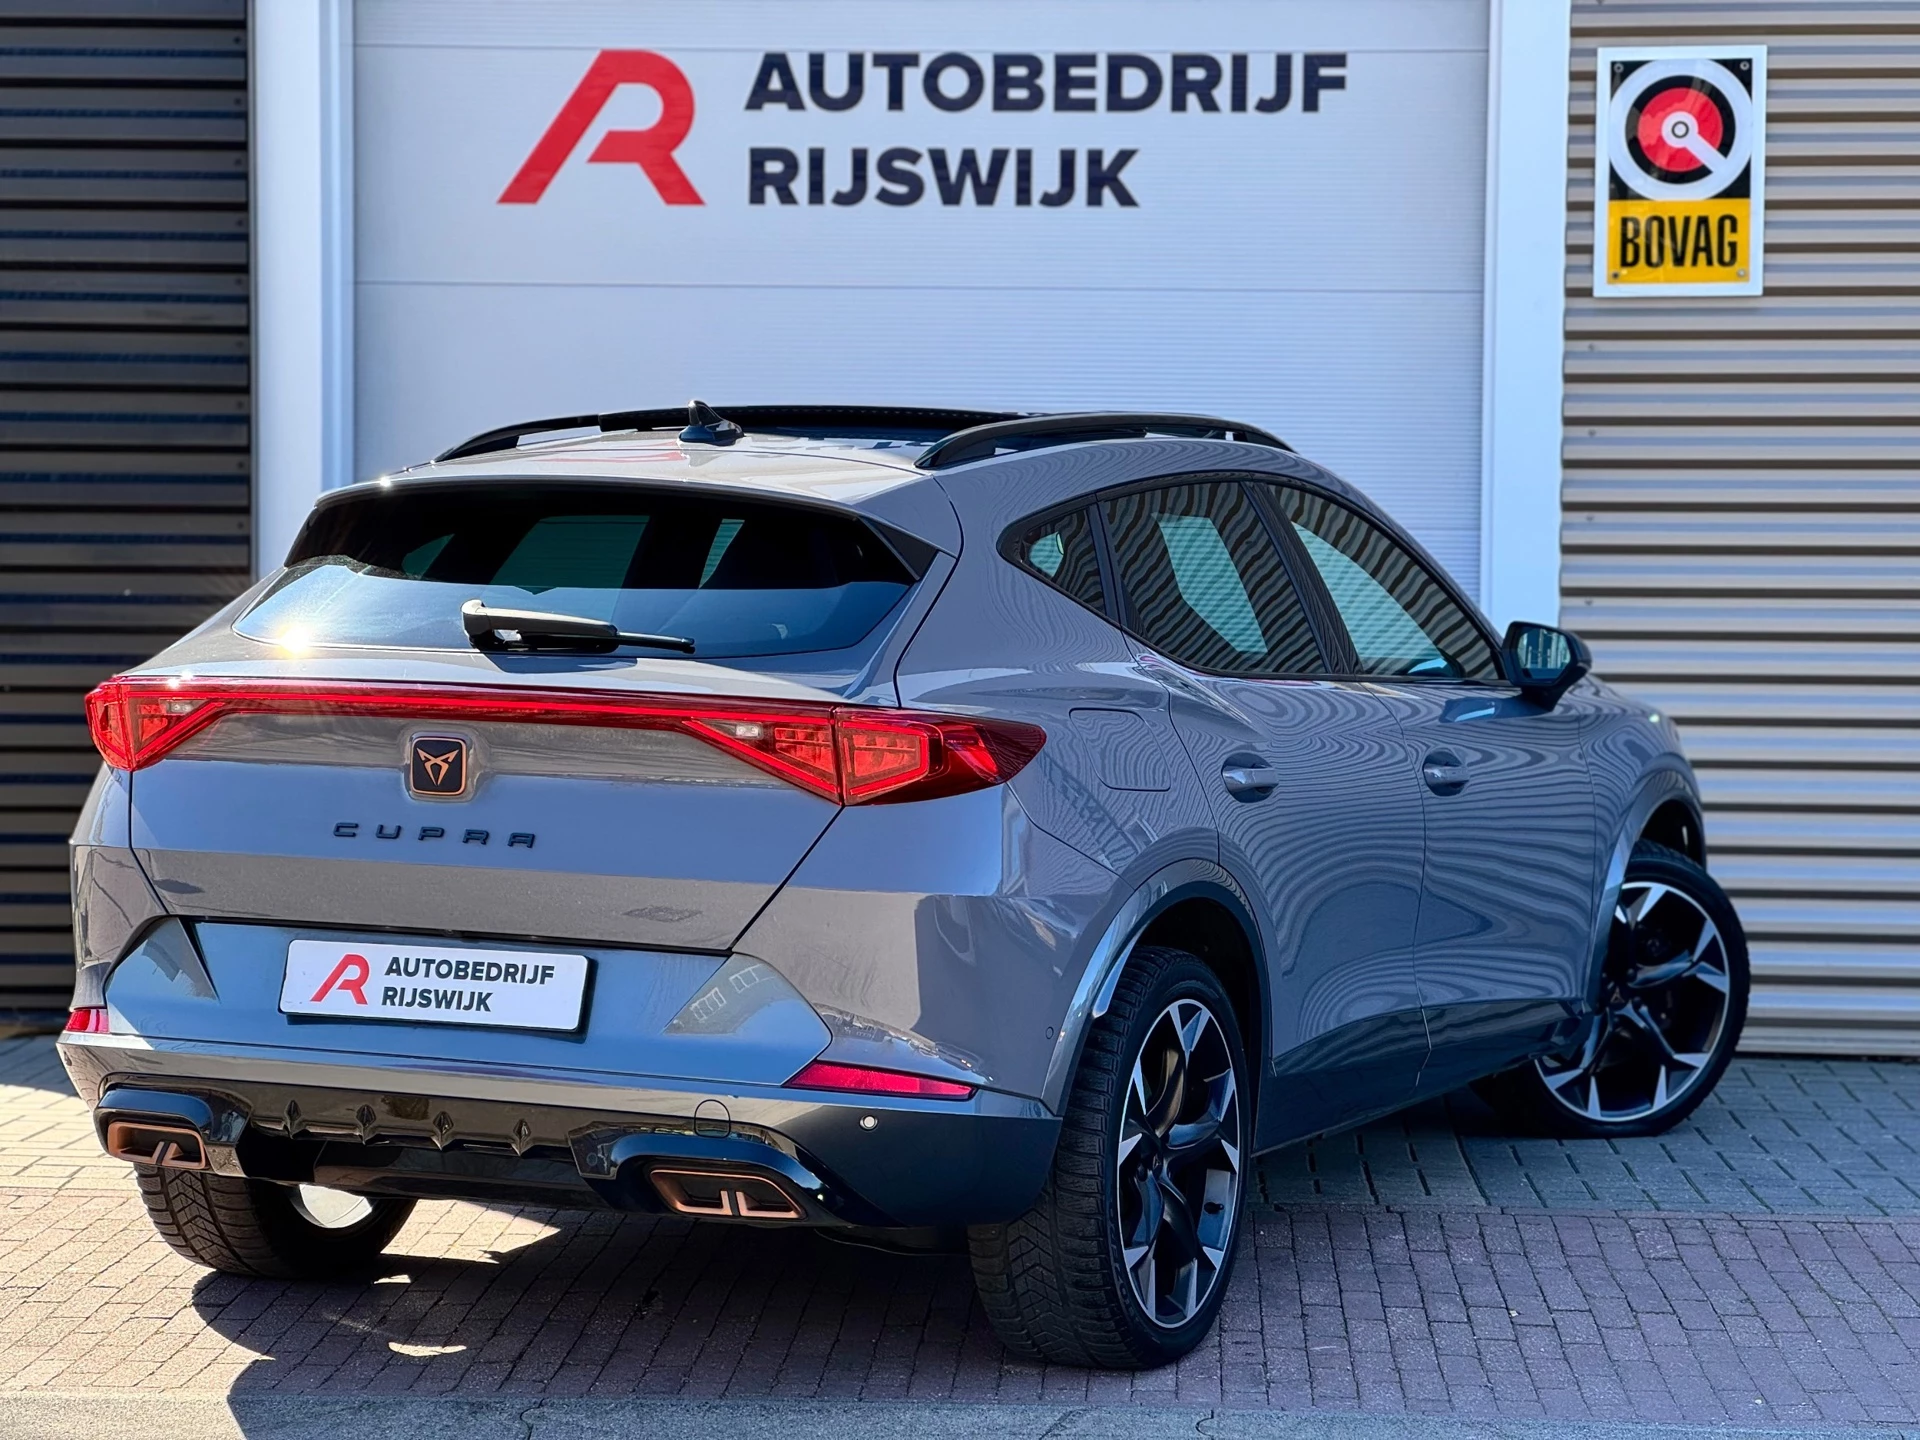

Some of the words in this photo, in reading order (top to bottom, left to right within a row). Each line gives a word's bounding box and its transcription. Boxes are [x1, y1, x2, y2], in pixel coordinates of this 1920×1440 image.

[745, 51, 1348, 114] AUTOBEDRIJF
[748, 146, 1141, 207] RIJSWIJK
[1620, 214, 1738, 268] BOVAG
[333, 822, 536, 848] CUPRA
[384, 956, 555, 985] AUTOBEDRIJF
[381, 986, 493, 1012] RIJSWIJK
